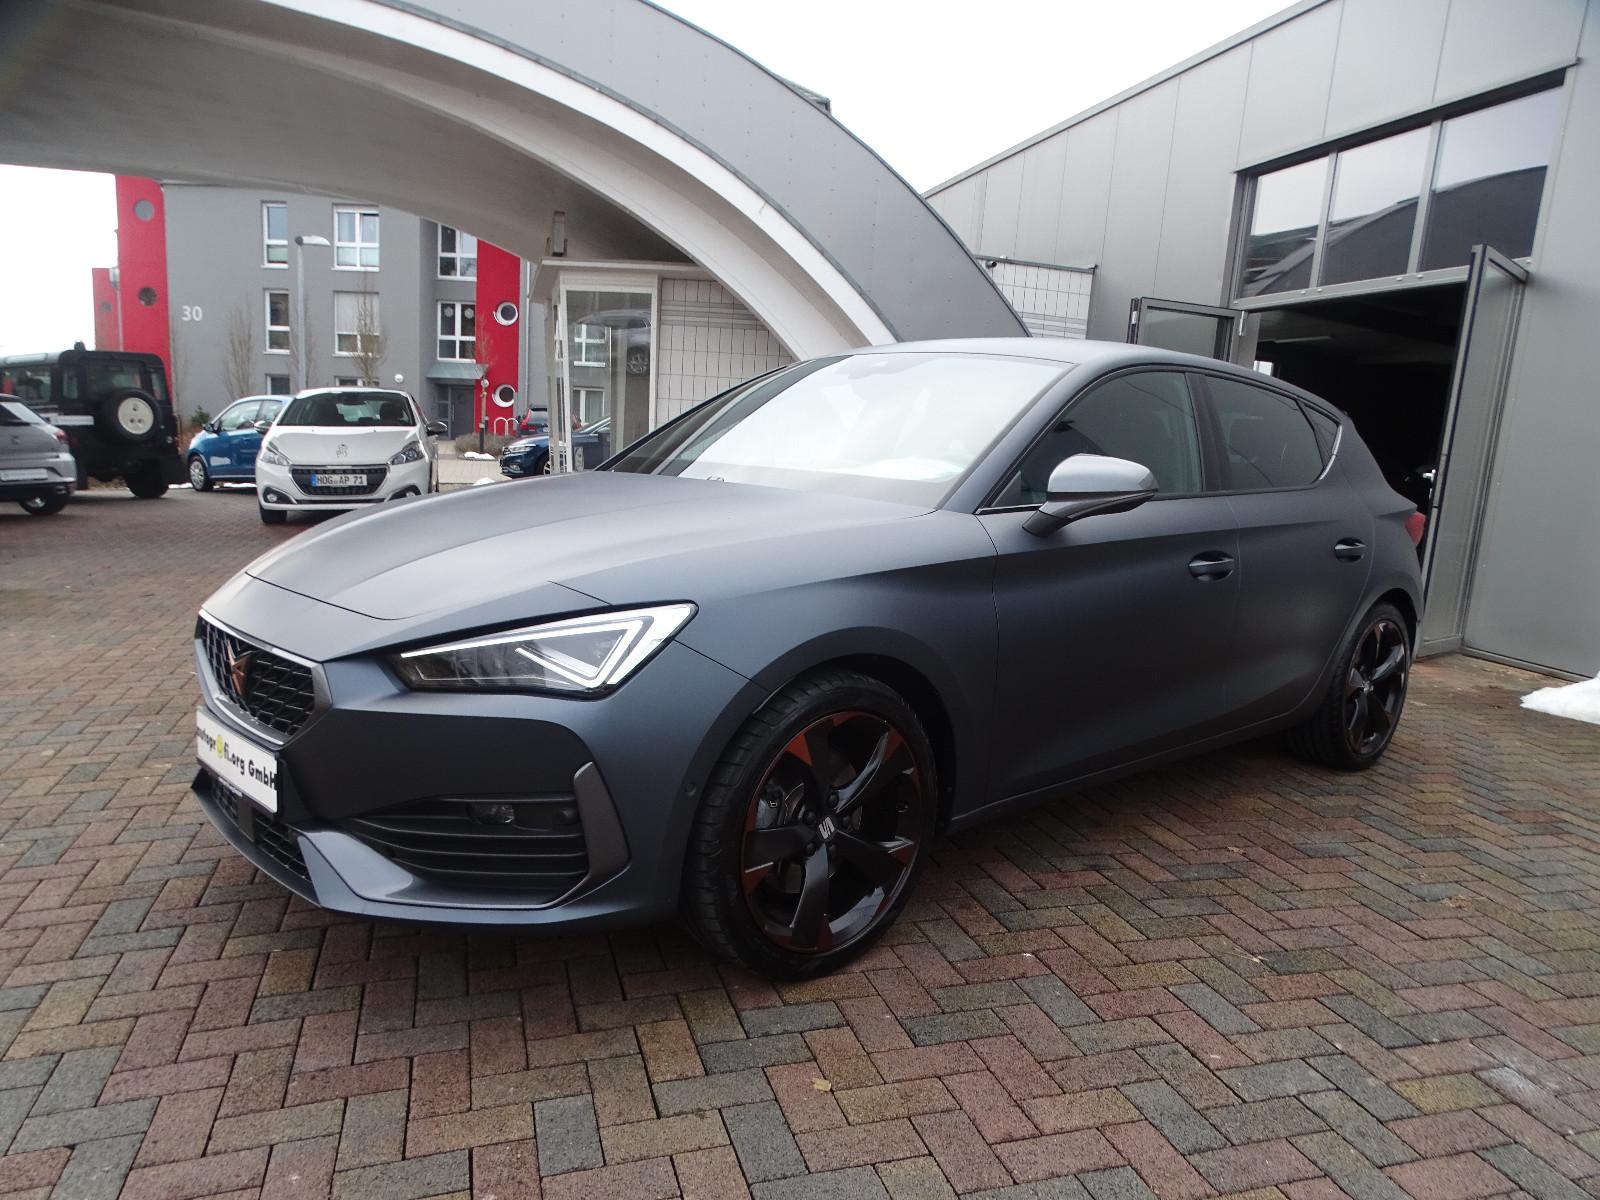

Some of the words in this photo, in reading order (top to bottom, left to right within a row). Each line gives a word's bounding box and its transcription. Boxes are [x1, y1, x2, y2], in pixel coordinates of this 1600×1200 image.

[181, 305, 203, 321] 30
[317, 475, 334, 485] HOG
[340, 475, 350, 485] AP
[353, 475, 364, 485] 71
[248, 759, 277, 790] GmbH
